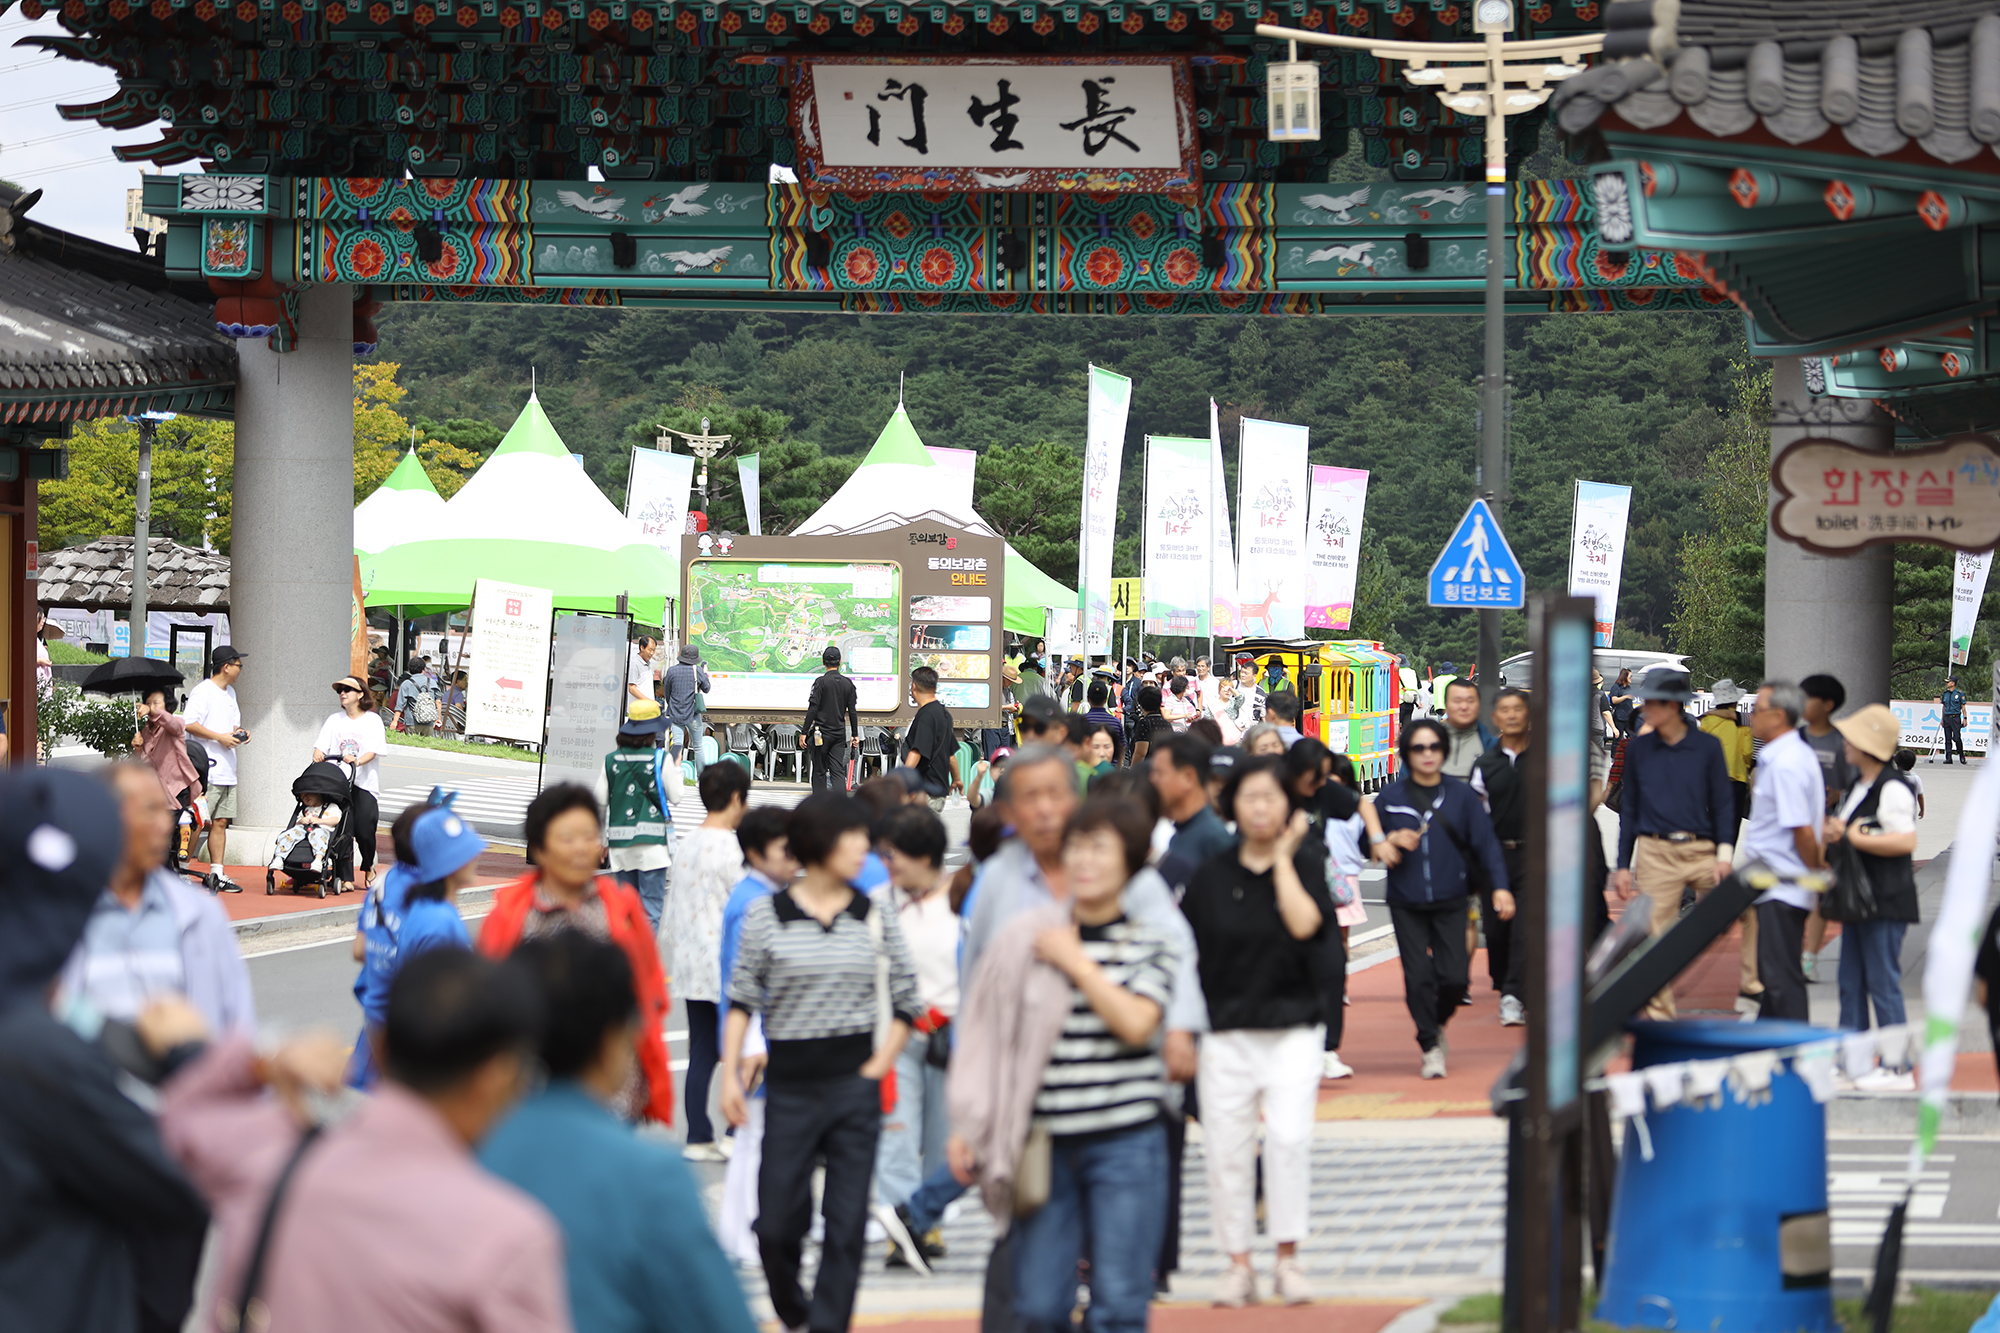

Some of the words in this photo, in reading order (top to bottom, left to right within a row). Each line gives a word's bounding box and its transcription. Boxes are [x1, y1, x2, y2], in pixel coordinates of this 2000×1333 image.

[1821, 467, 1954, 507] 화장실
[1816, 515, 1859, 531] toilet
[1323, 533, 1344, 548] 축제
[927, 557, 988, 571] 동의보감촌
[1586, 550, 1607, 565] 축제
[950, 573, 988, 587] 안내도
[1443, 584, 1512, 602] 횡단보도
[966, 655, 990, 678] 秋
[491, 693, 508, 703] 오후
[510, 695, 524, 705] 2시
[966, 685, 989, 707] 冬
[482, 702, 503, 713] 장소:
[516, 707, 534, 718] 광장
[1920, 708, 1991, 733] 스프
